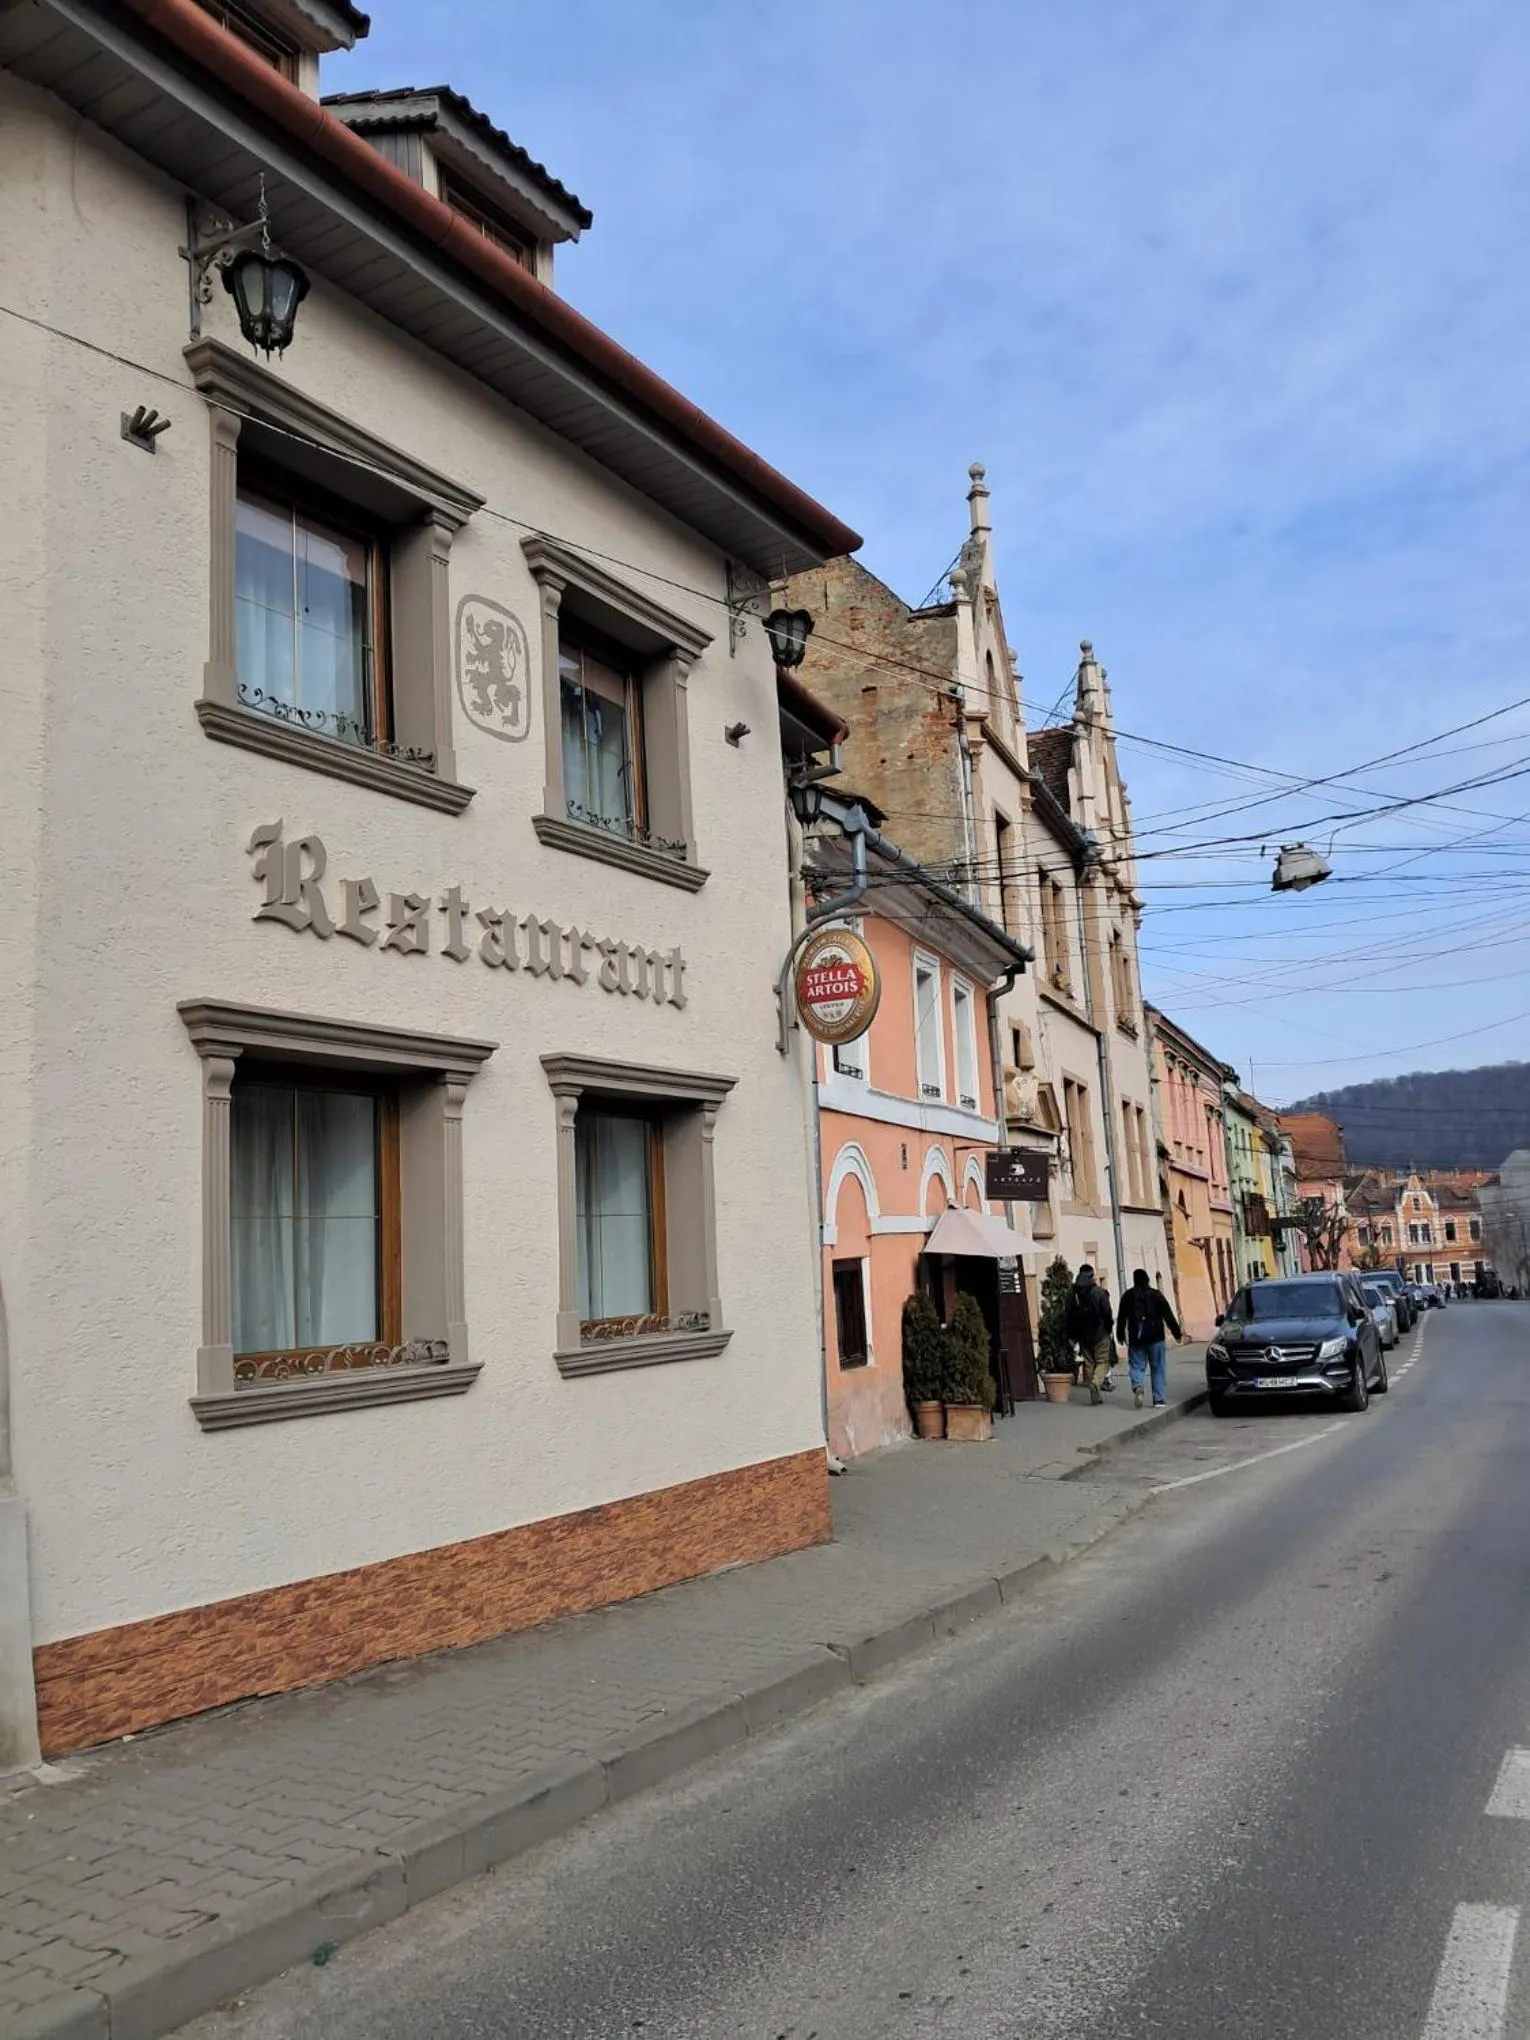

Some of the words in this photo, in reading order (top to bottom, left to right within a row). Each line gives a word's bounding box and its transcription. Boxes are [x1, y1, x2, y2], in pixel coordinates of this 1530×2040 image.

[247, 818, 687, 1010] Restaurant
[807, 969, 856, 985] STELLA
[807, 980, 858, 997] ARTOIS
